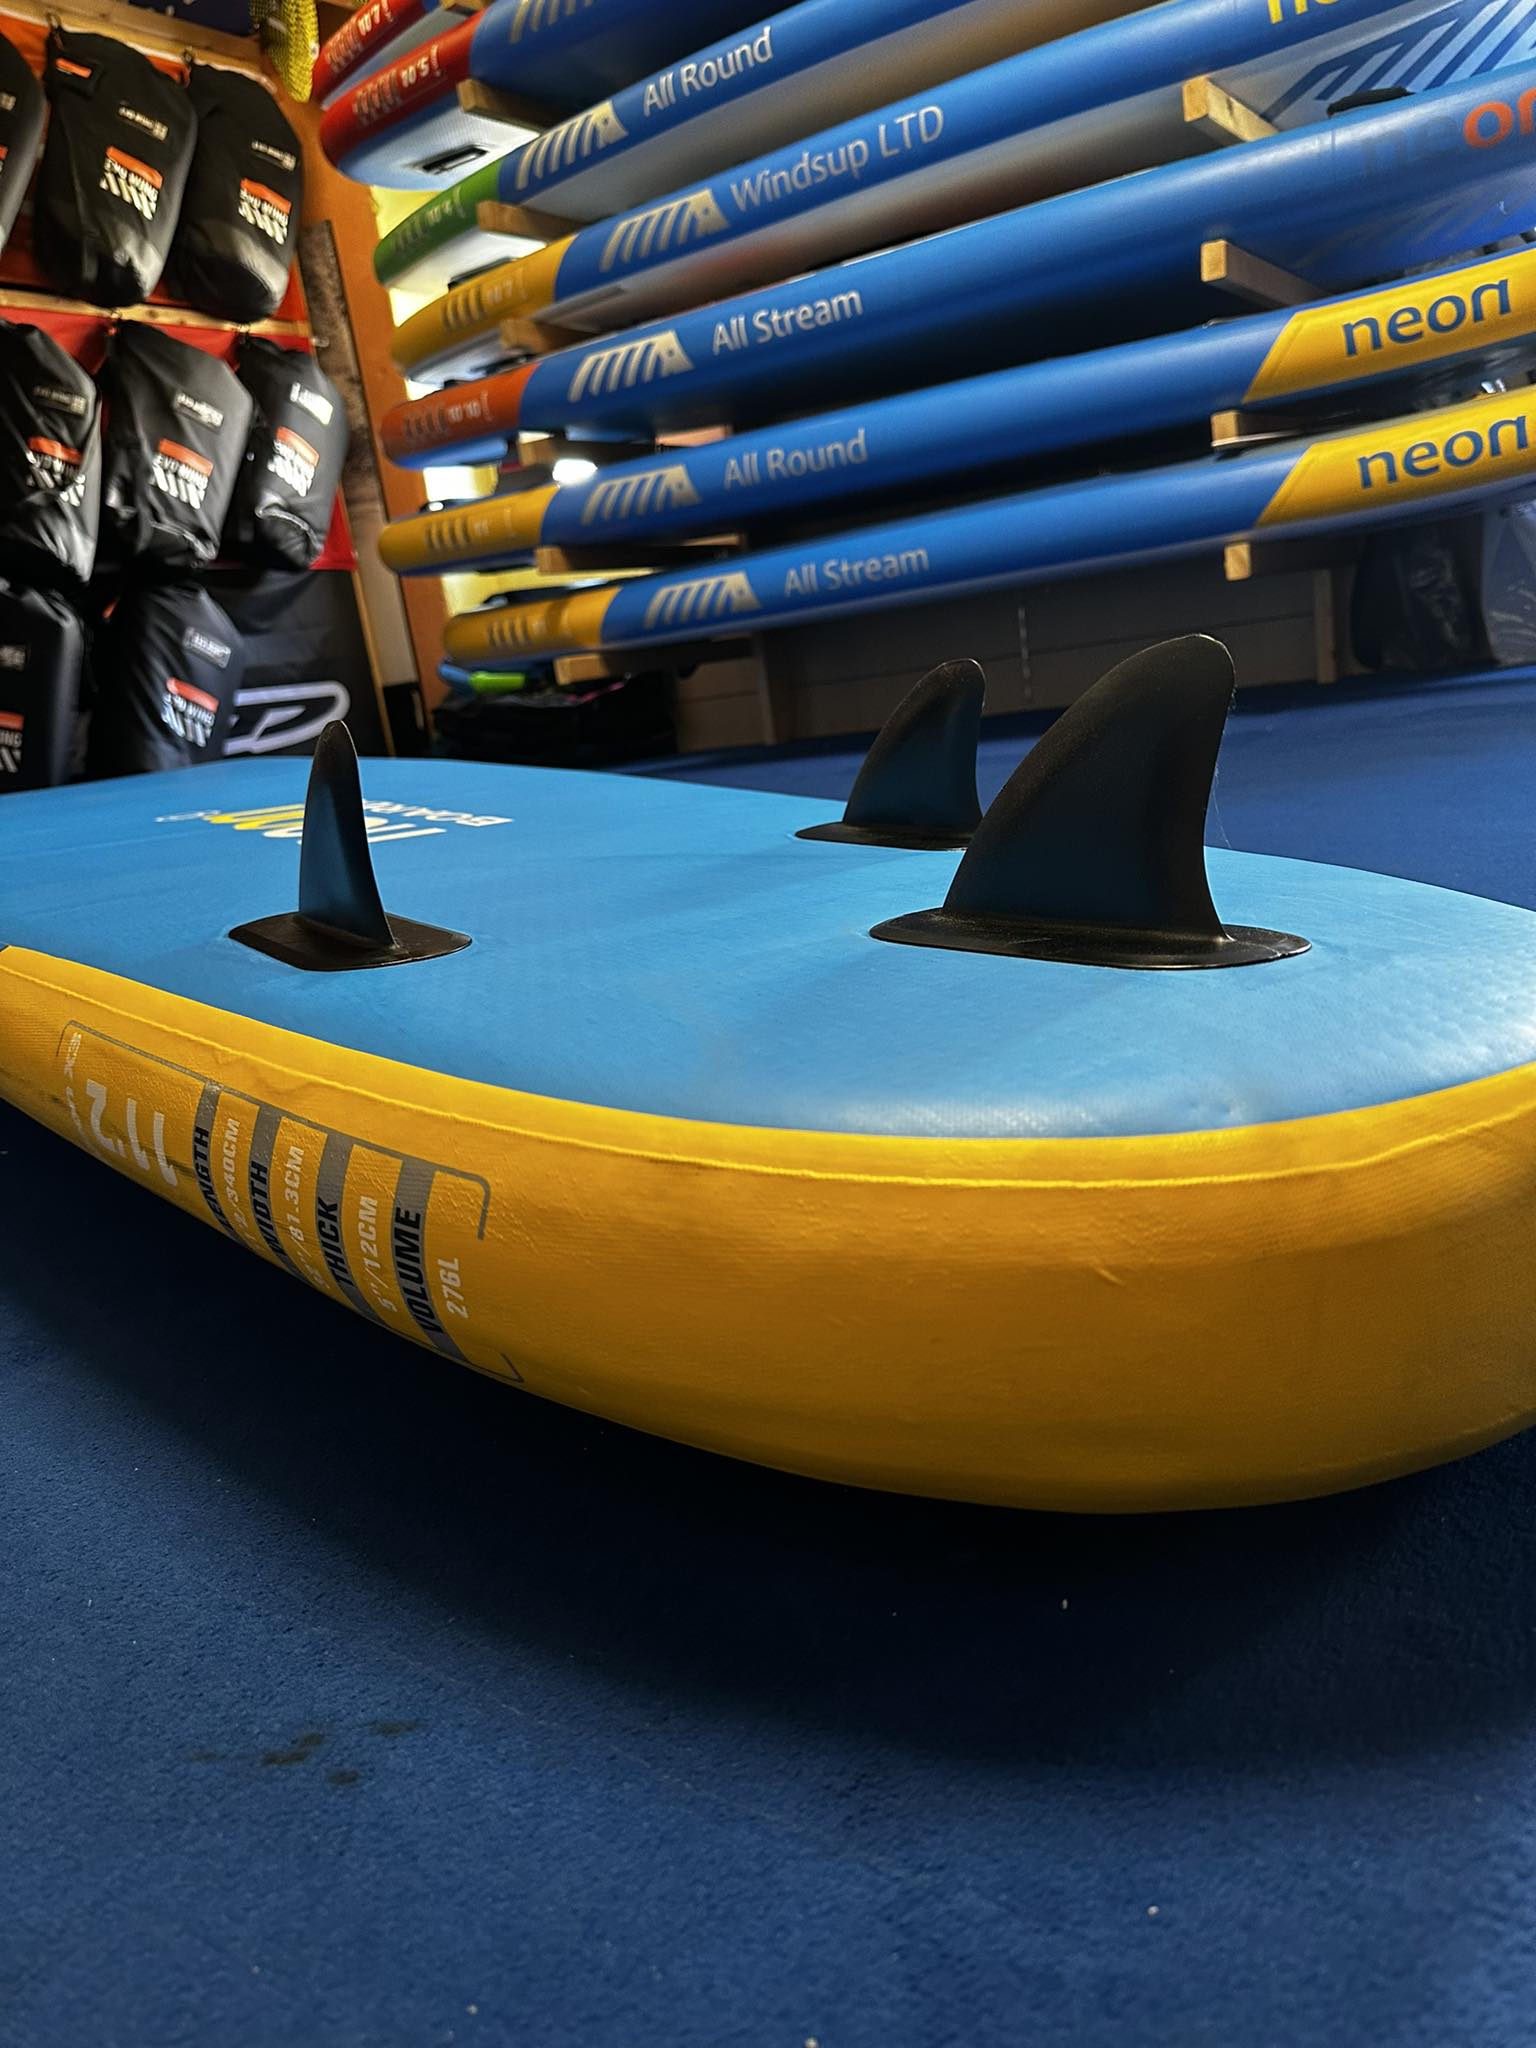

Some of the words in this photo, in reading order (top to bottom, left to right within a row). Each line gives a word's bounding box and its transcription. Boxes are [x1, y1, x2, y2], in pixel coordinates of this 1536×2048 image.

[642, 72, 676, 117] All
[681, 26, 774, 97] Round
[729, 138, 870, 212] Windsup
[877, 105, 945, 158] LTD
[712, 314, 747, 354] All
[752, 289, 864, 344] Stream
[1343, 278, 1512, 358] neon
[724, 453, 760, 491] All
[767, 428, 868, 478] Round
[1357, 414, 1530, 490] neon
[784, 564, 816, 597] All
[826, 548, 930, 591] Stream
[193, 1126, 236, 1236] LENGTH
[249, 1160, 288, 1257] WIDTH
[317, 1196, 358, 1288] THICK
[394, 1206, 445, 1334] VOLUME
[437, 1256, 469, 1319] 276L
